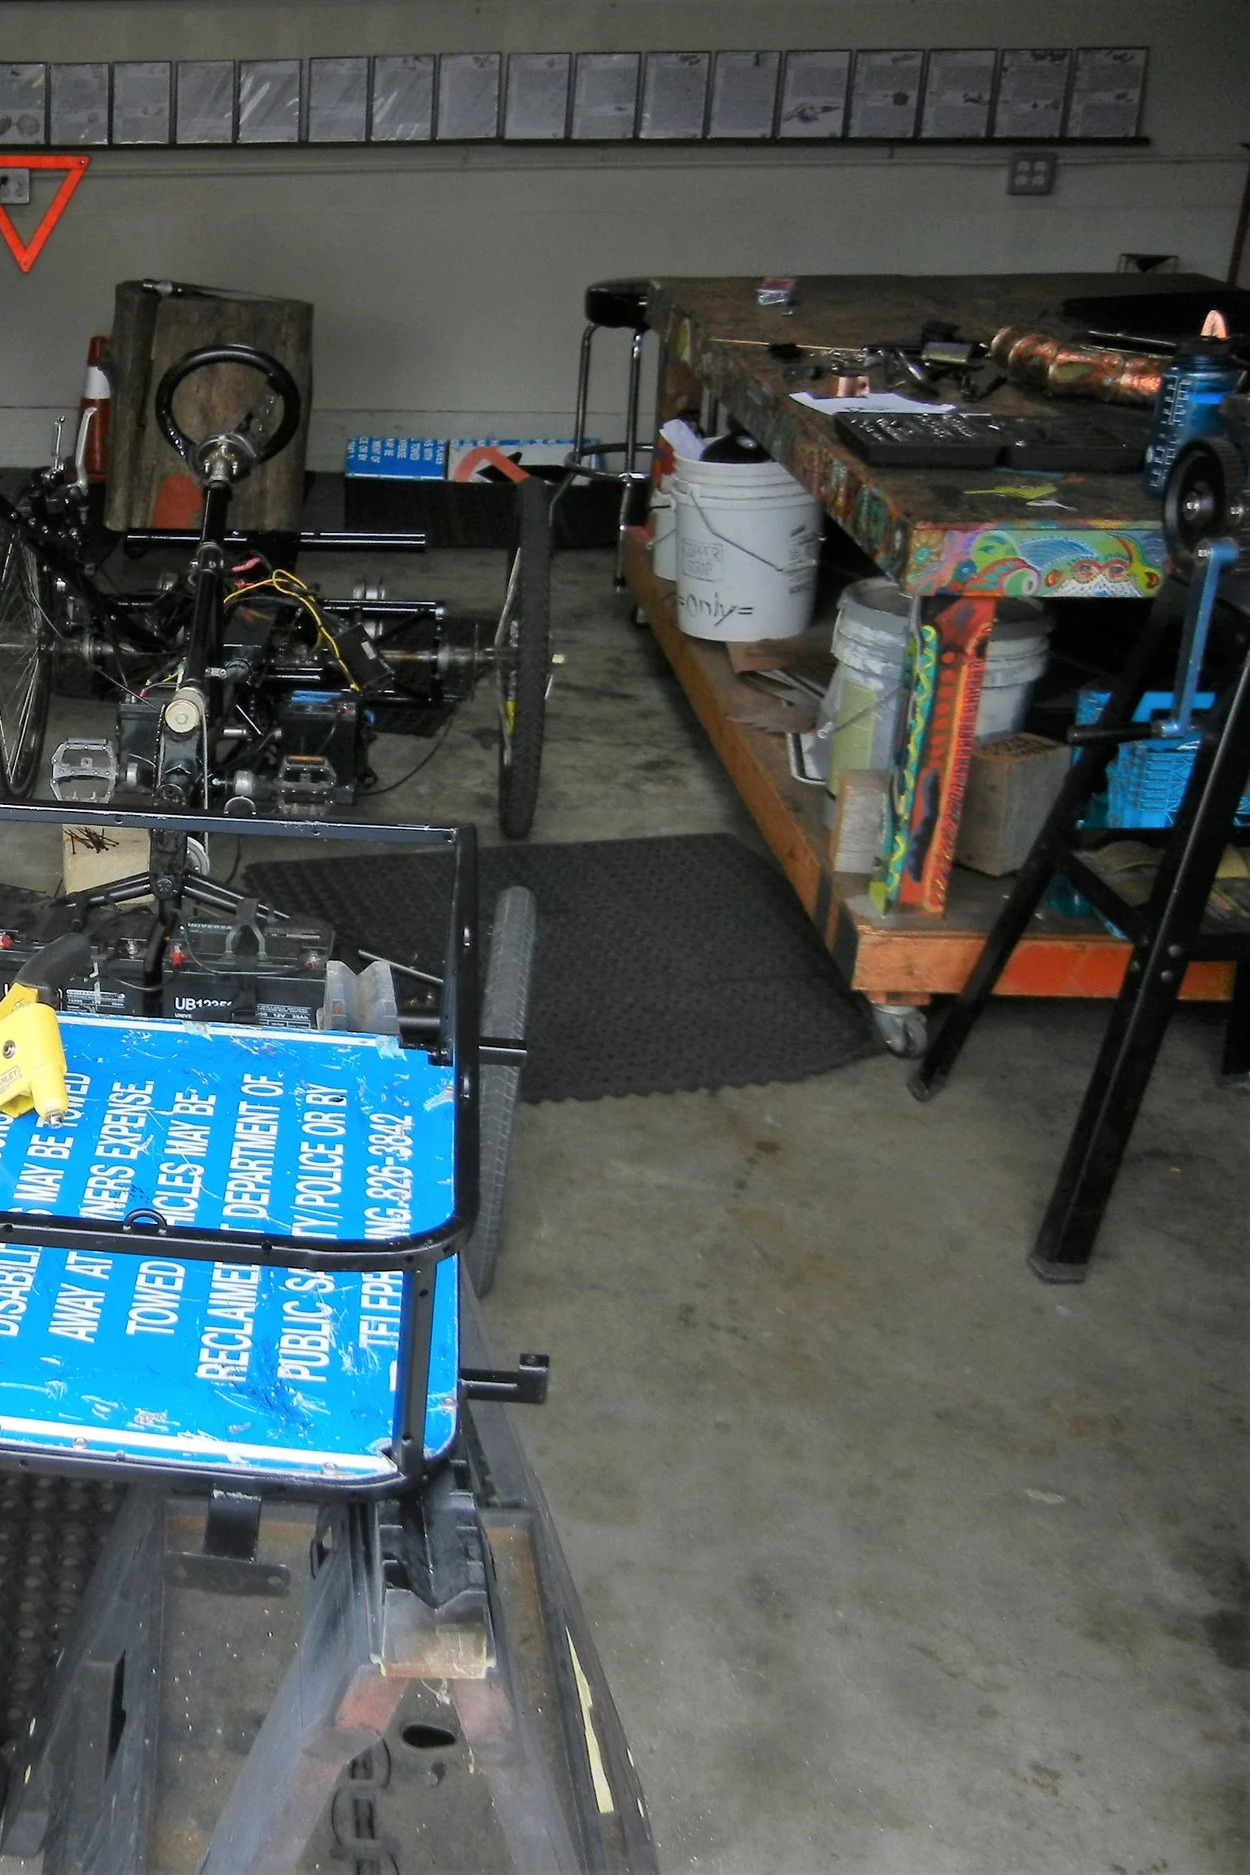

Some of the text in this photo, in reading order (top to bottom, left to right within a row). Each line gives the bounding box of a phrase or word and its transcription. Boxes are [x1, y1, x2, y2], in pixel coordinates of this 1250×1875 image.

[188, 922, 233, 930] UNIVERSA
[241, 1073, 284, 1097] OF
[305, 1083, 348, 1107] BY
[171, 1091, 217, 1117] BE
[164, 1119, 211, 1157] MAY
[301, 1111, 346, 1137] OR
[27, 1133, 75, 1160] BE
[222, 1101, 281, 1218] DEPARTMENT
[365, 1113, 414, 1200] 826-3842
[13, 1163, 65, 1203] MAY
[65, 1251, 113, 1280] AT
[48, 1282, 106, 1343] AWAY
[125, 1260, 186, 1335] TOWED
[277, 1301, 333, 1383] PUBLIC
